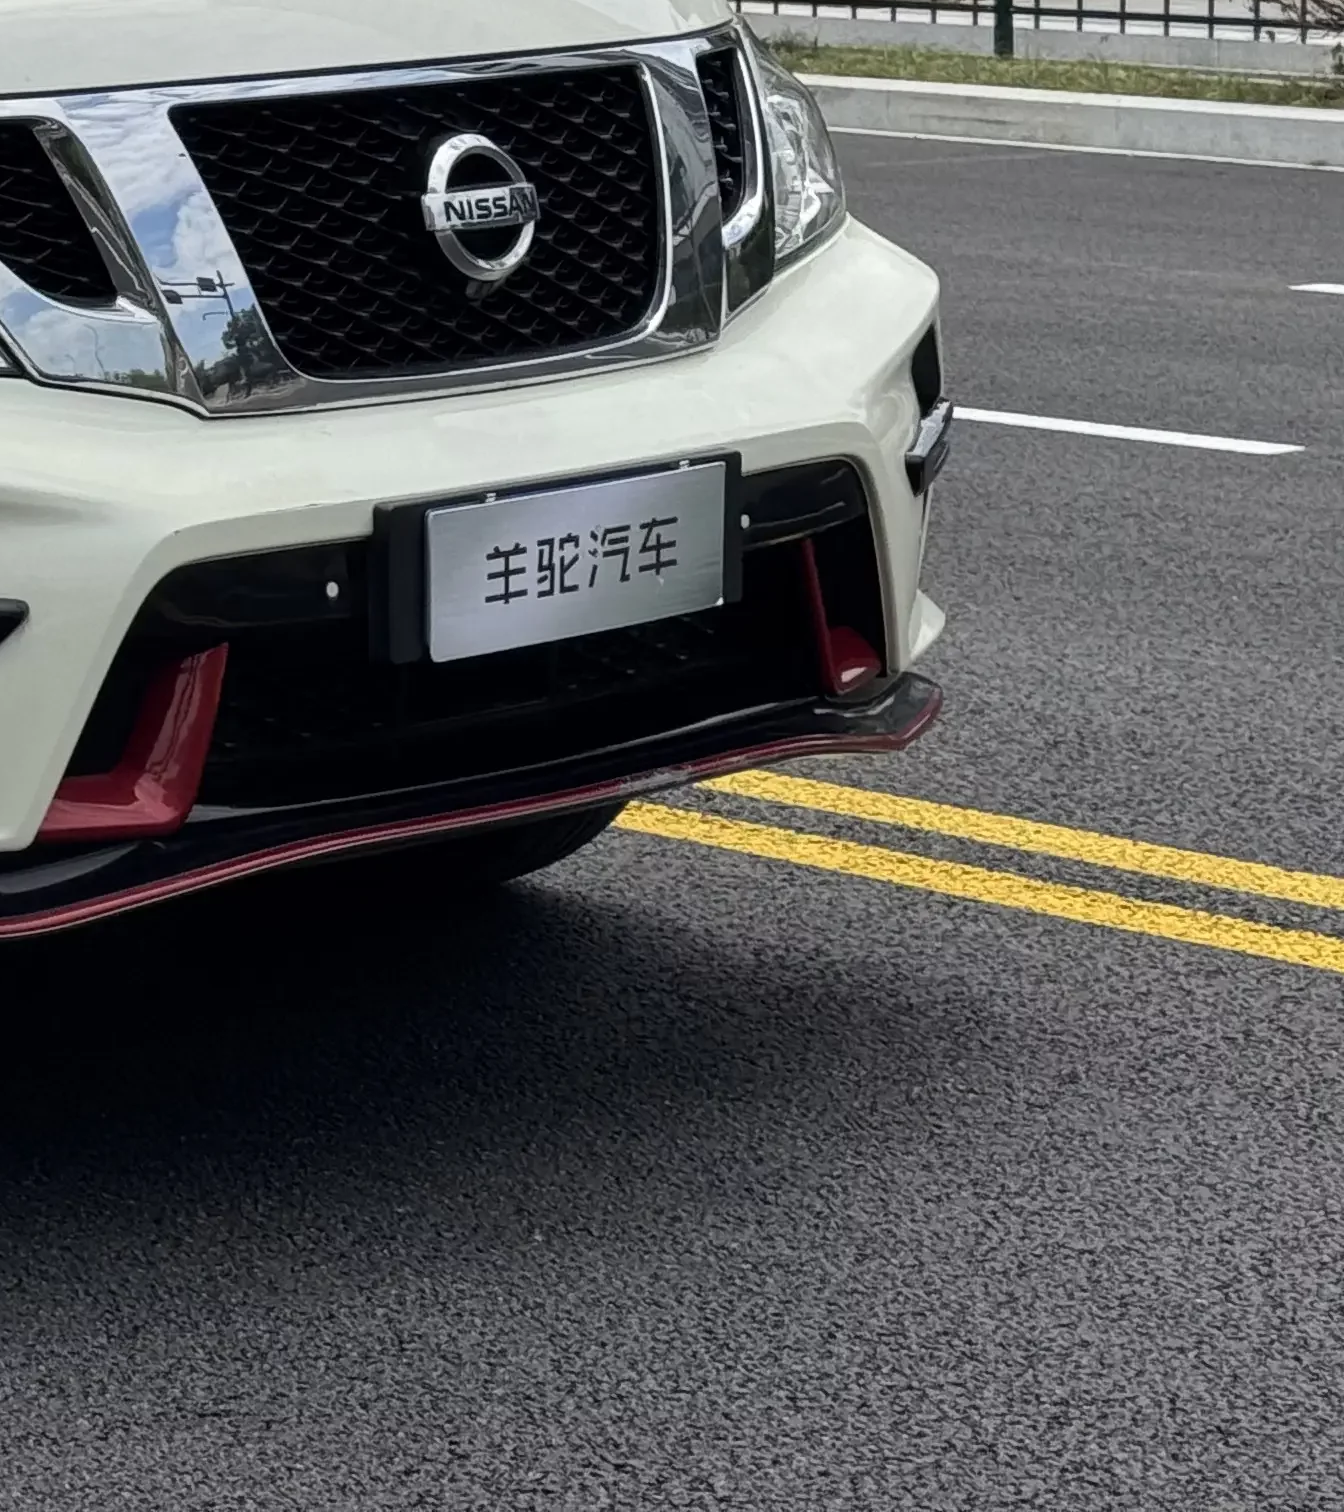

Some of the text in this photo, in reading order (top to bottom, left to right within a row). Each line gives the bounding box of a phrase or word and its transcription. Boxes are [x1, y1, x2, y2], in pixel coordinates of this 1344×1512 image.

[443, 191, 534, 223] NISSAN
[485, 516, 678, 604] 羊驼汽车
